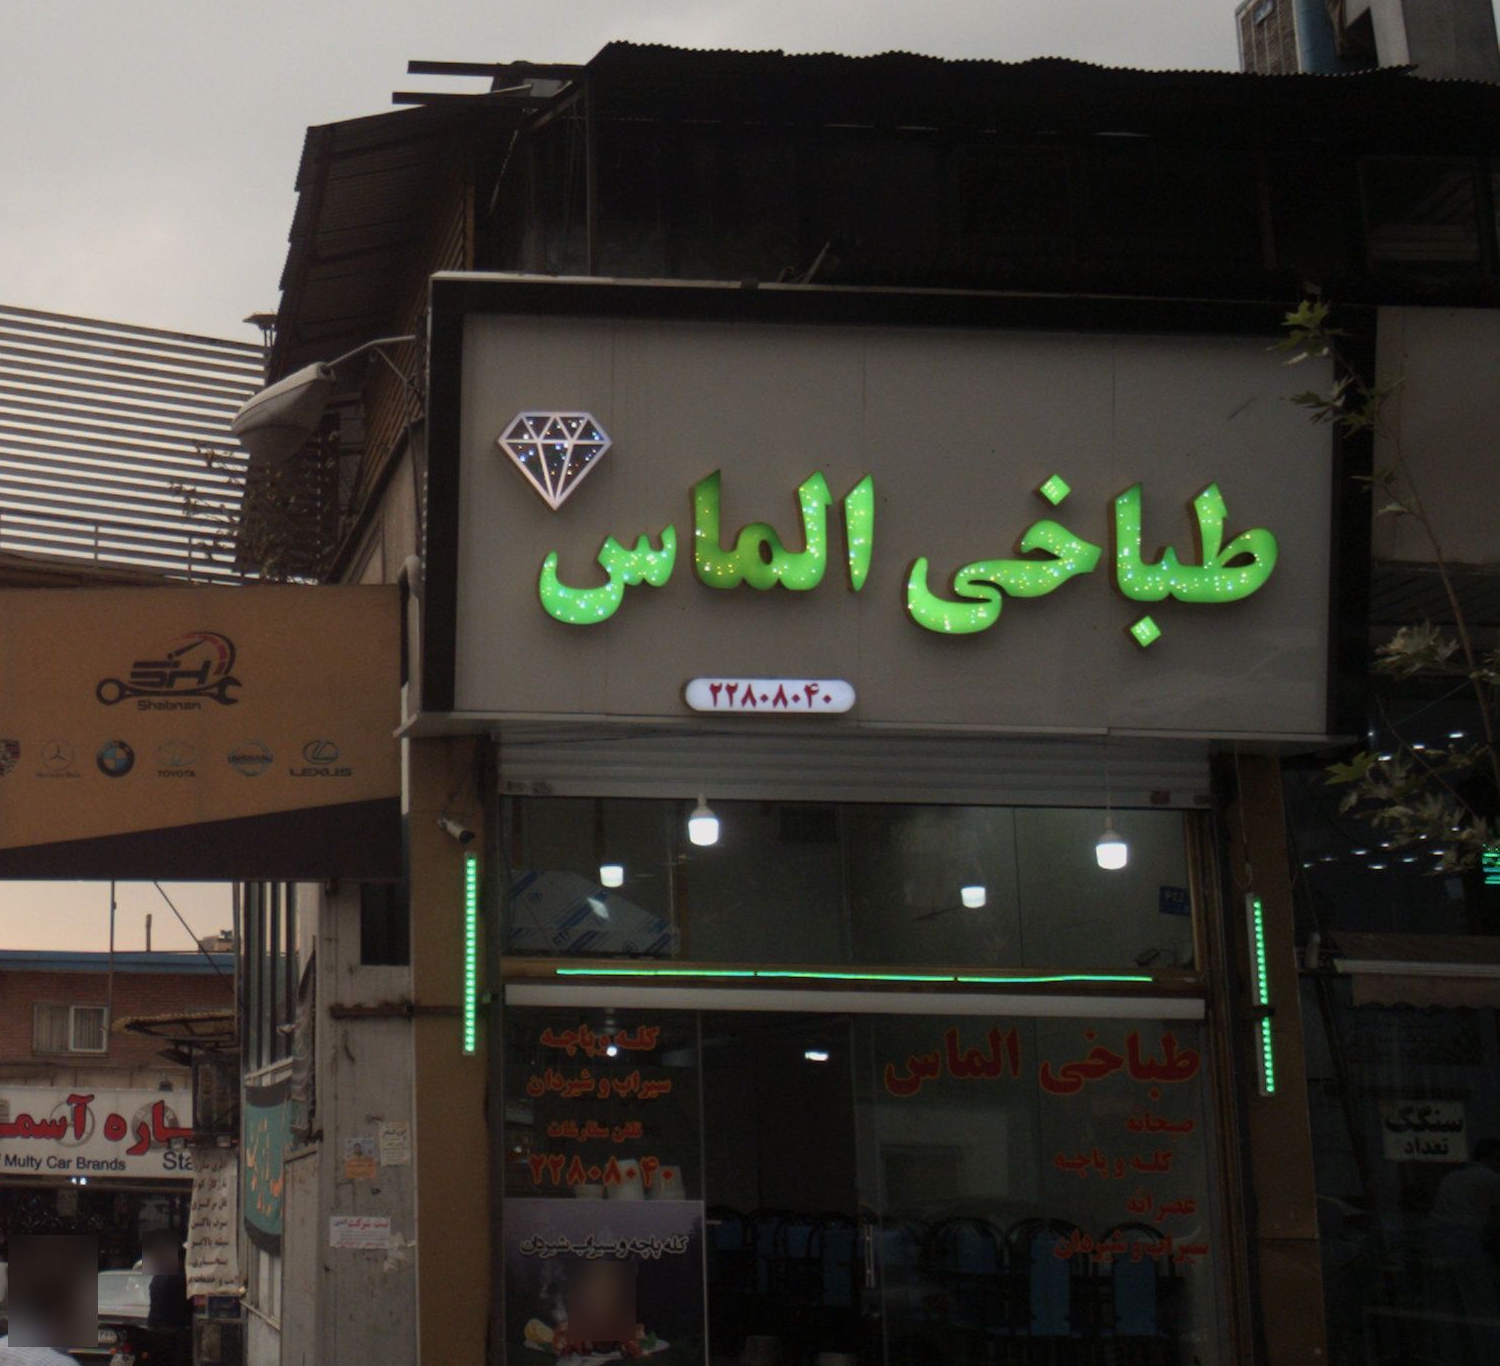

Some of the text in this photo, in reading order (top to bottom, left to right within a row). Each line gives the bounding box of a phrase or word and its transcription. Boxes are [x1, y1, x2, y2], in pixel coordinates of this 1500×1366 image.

[537, 468, 1281, 648] طباخی الماس
[708, 681, 833, 708] ۲۲۸۰۸۰۴۰
[157, 769, 196, 778] TOYOTA
[289, 767, 353, 778] LEXUS
[540, 1023, 596, 1057] پاچه
[613, 1024, 661, 1051] کله
[885, 1027, 1200, 1101] طباخی الماس
[526, 1068, 596, 1099] شیردان
[597, 1077, 611, 1100] و
[1126, 1105, 1196, 1141] صبحانه
[4, 1154, 42, 1170] Multy
[46, 1155, 73, 1169] Car
[76, 1157, 126, 1171] Brands
[162, 1151, 193, 1170] Sta
[528, 1153, 675, 1188] ۲۲۸۰۸۰۴۰
[1053, 1146, 1173, 1179] کله و پاچه
[1127, 1188, 1197, 1222] عصرانه
